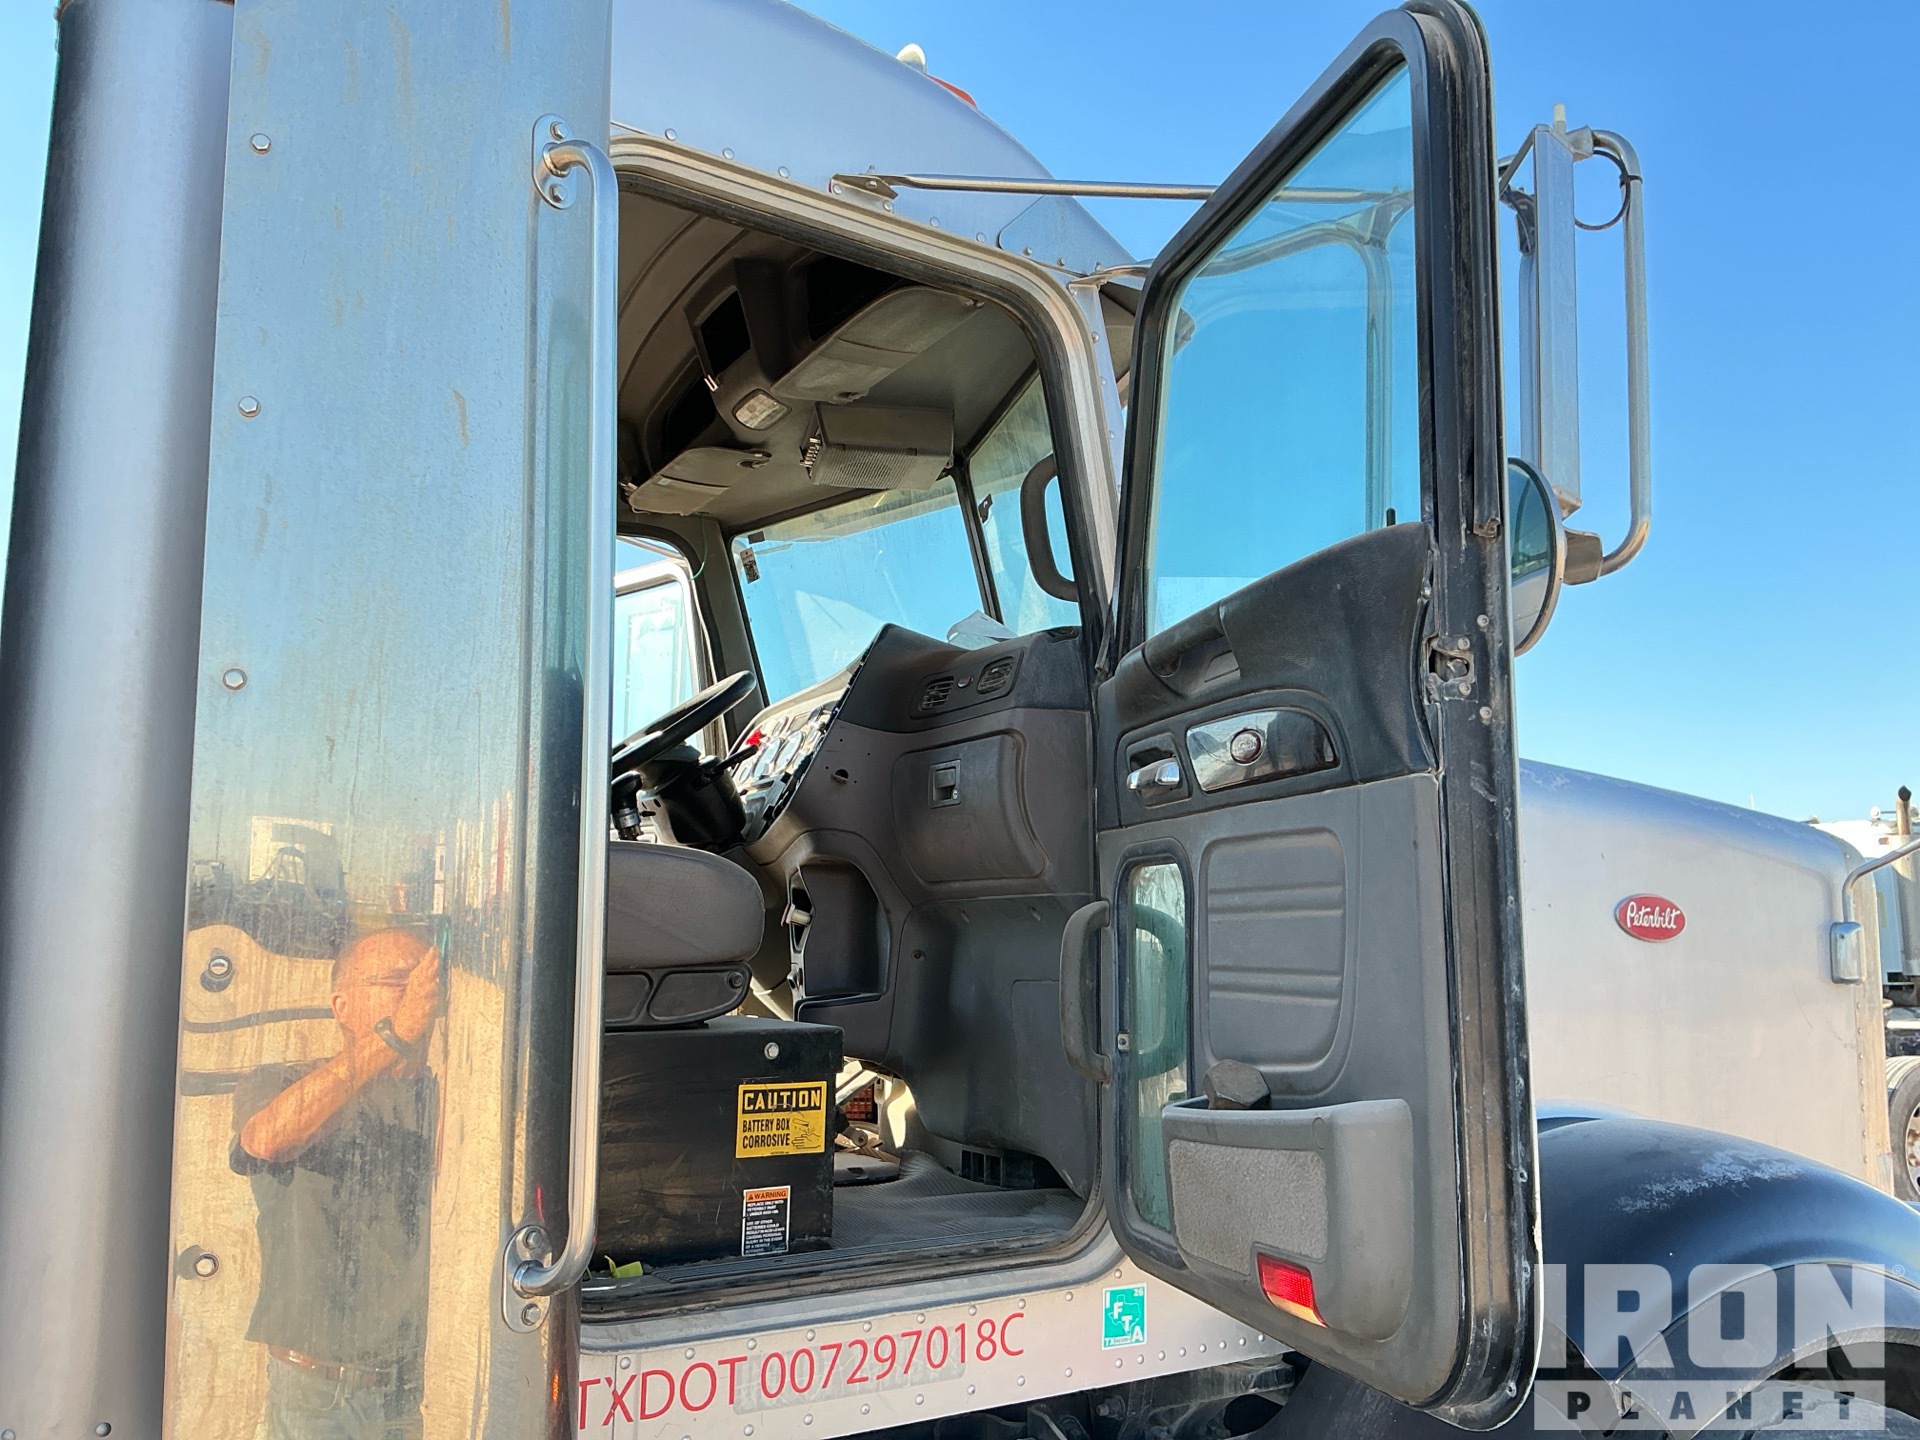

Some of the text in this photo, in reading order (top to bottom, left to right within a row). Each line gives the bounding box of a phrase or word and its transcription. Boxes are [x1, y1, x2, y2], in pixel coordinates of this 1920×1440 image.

[1626, 901, 1681, 930] Peterbilt
[744, 1089, 821, 1111] CAUTION
[742, 1117, 790, 1133] BATTERY BOX
[742, 1133, 790, 1149] CORROSIVE
[755, 1190, 787, 1200] WARNING
[1104, 1337, 1115, 1347] TX
[579, 1312, 1025, 1430] TXDOT 007297018C
